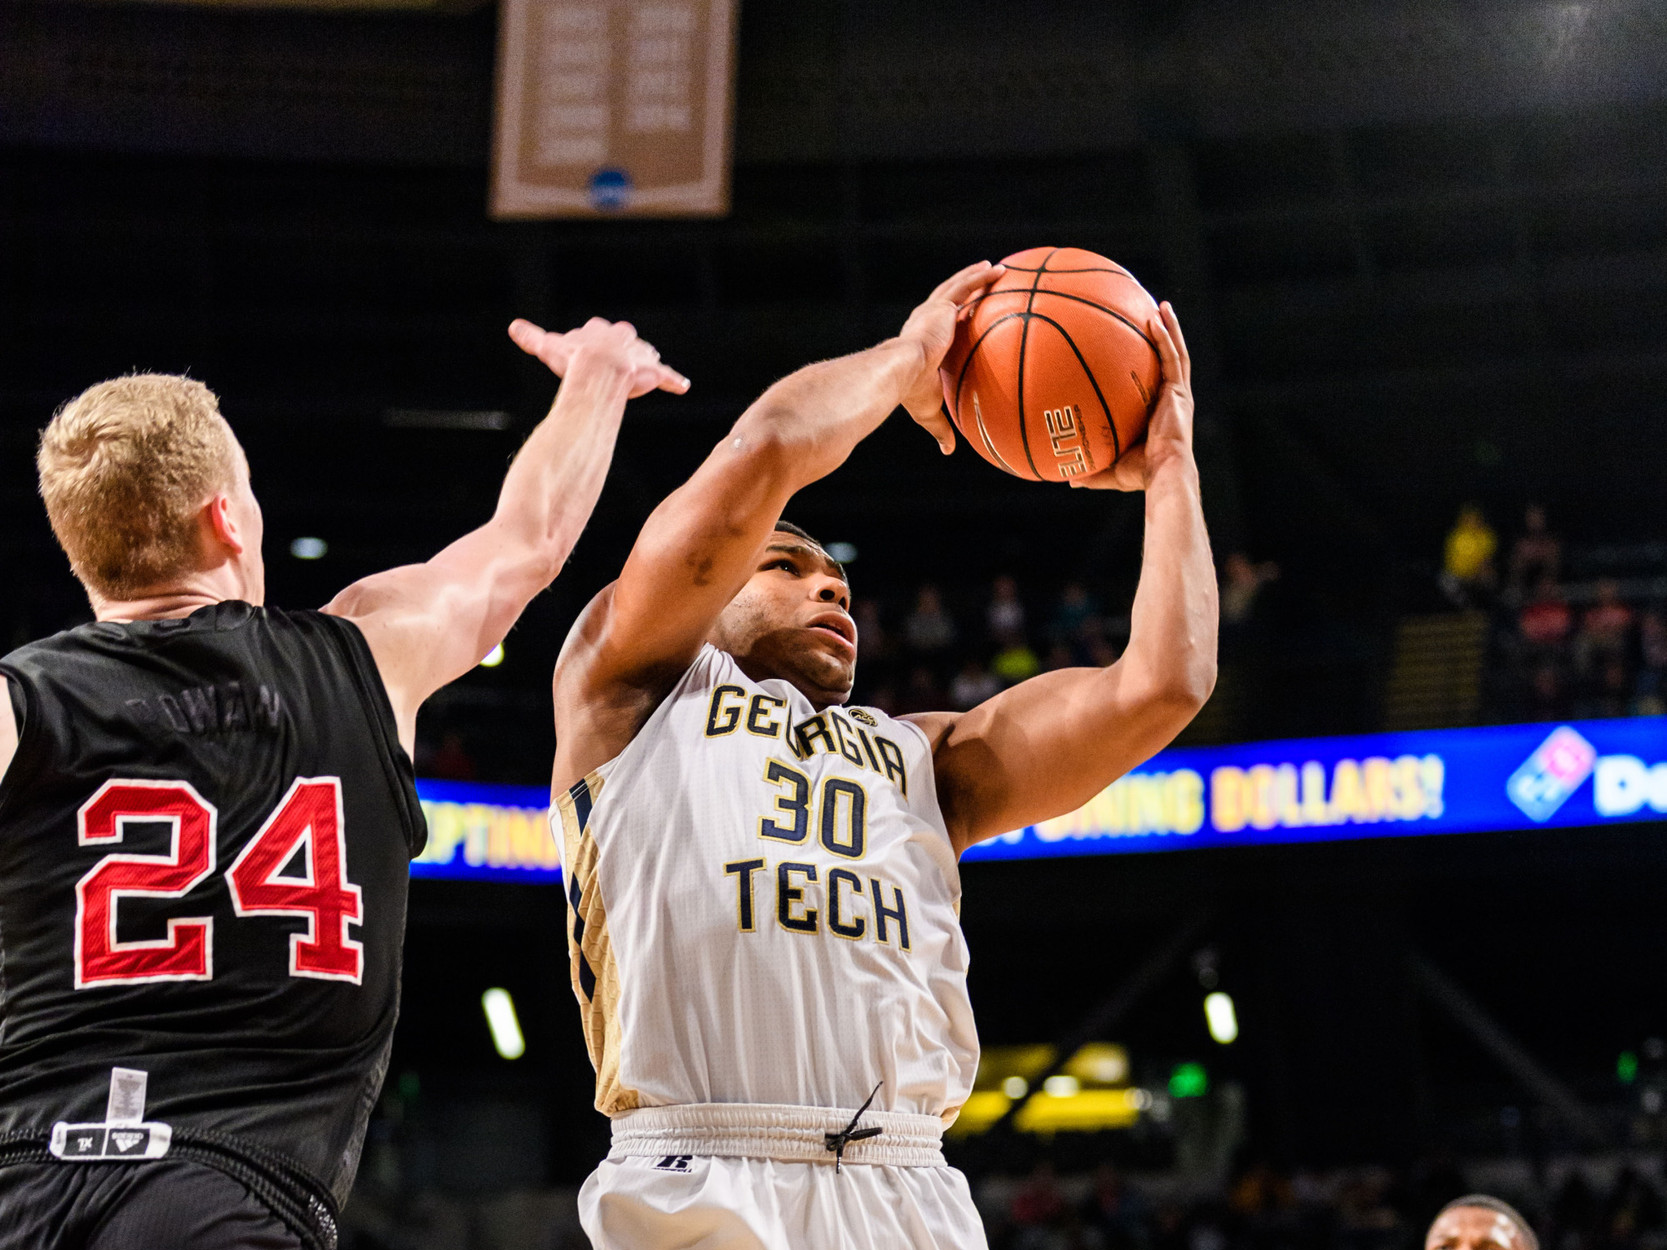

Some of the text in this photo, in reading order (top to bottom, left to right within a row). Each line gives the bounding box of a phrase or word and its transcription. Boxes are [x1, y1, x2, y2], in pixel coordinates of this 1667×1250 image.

[757, 757, 869, 861] 30
[1210, 754, 1445, 833] DOLLARS!
[74, 776, 364, 990] 24
[723, 856, 912, 953] TECH
